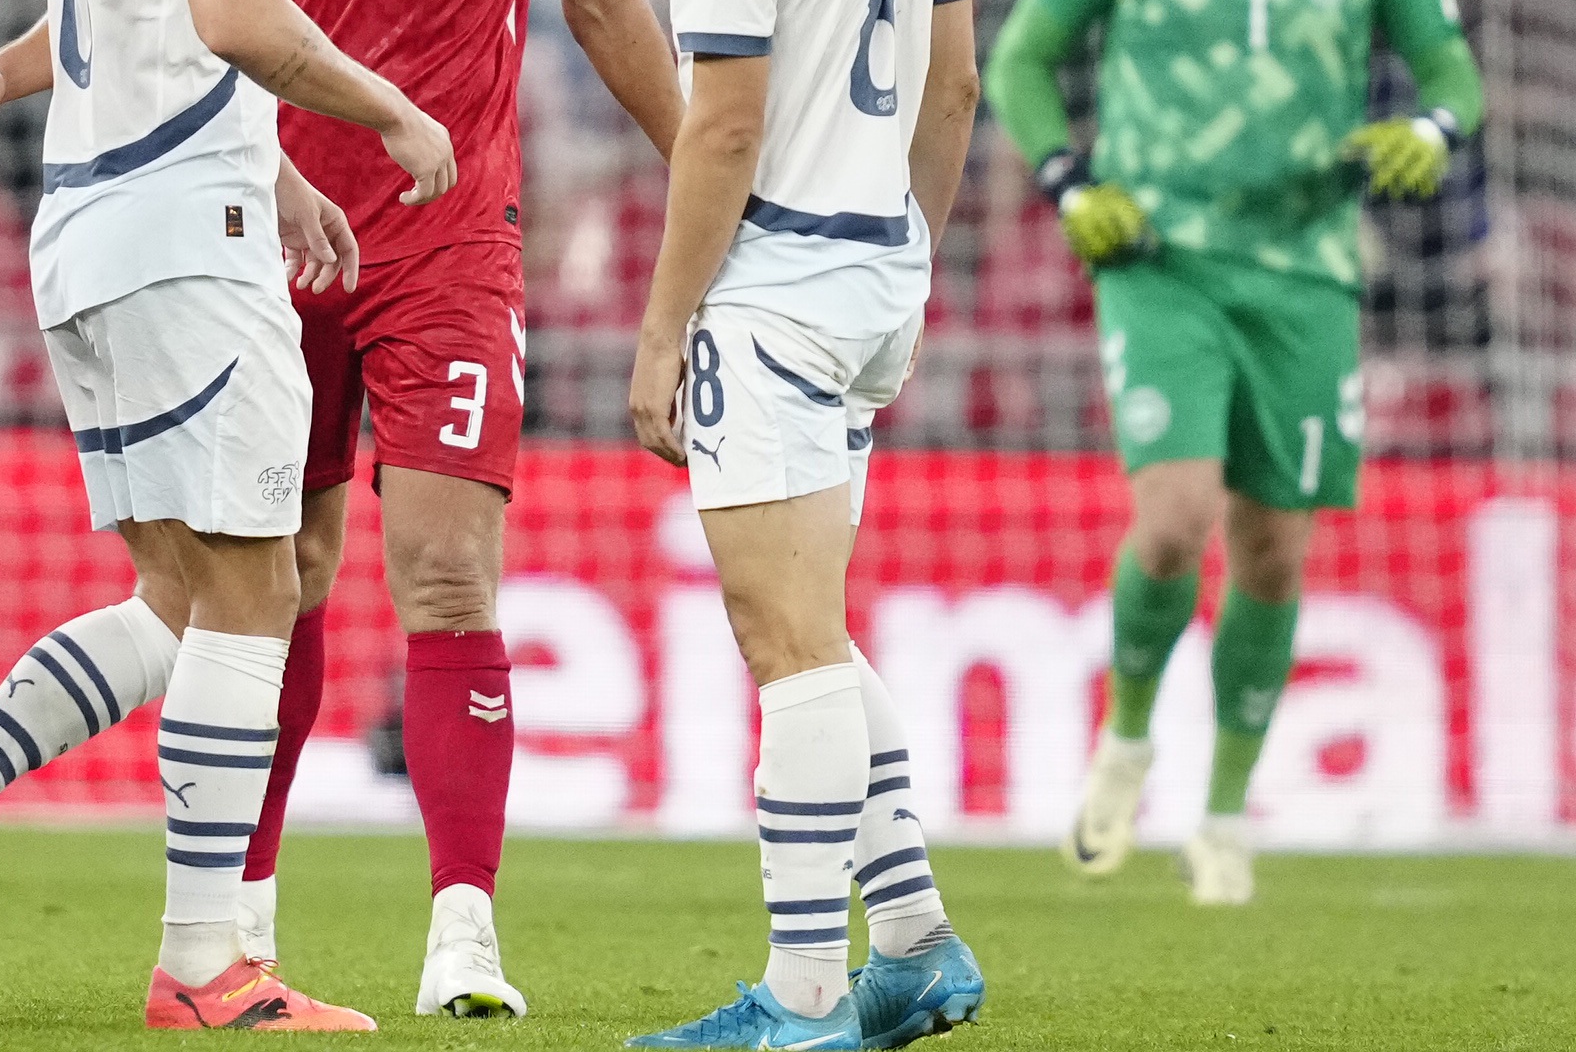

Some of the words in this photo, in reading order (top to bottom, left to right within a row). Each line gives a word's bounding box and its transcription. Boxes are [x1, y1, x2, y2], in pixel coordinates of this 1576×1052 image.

[439, 360, 488, 450] 3
[692, 328, 726, 429] 8
[1299, 414, 1323, 495] 1
